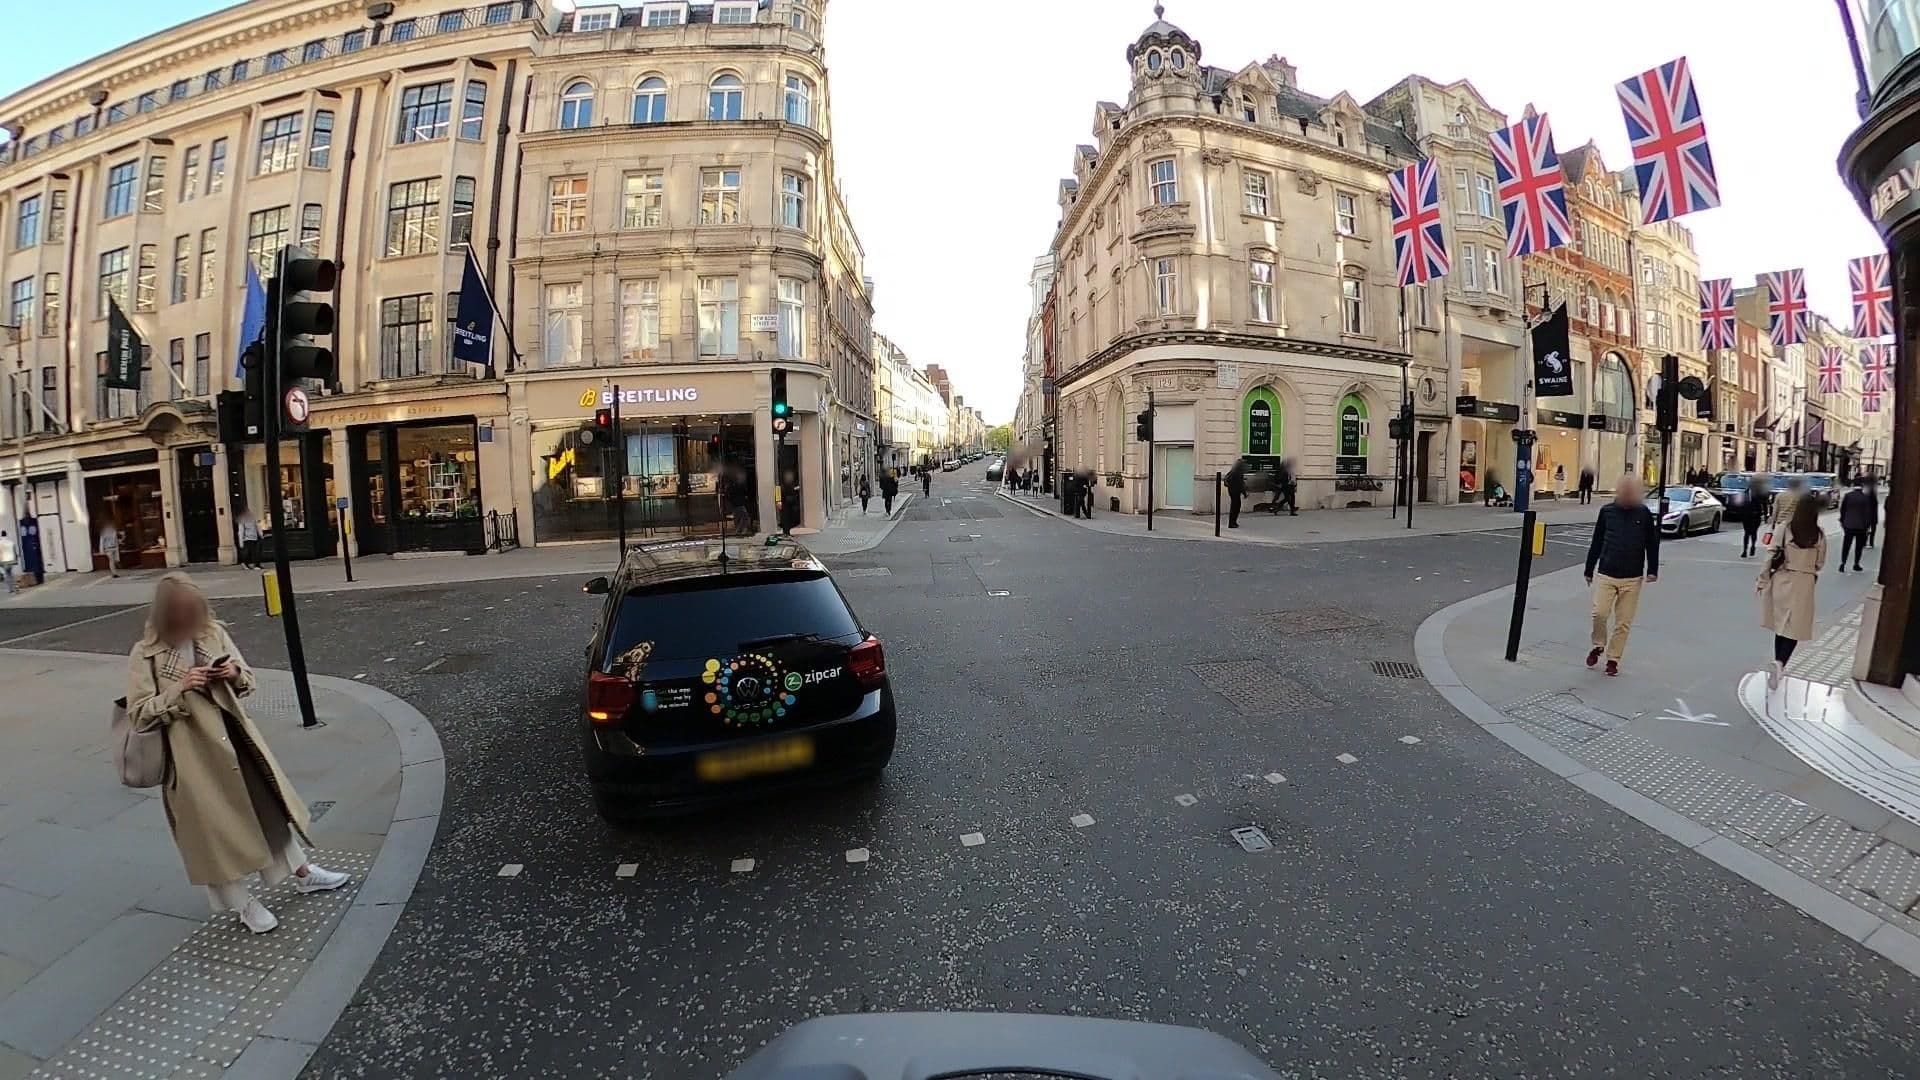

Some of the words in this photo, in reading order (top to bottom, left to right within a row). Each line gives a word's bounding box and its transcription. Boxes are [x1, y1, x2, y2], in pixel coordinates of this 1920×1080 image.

[1538, 376, 1568, 385] SWAINE
[602, 388, 698, 405] BREITLING
[804, 666, 842, 684] zipcar
